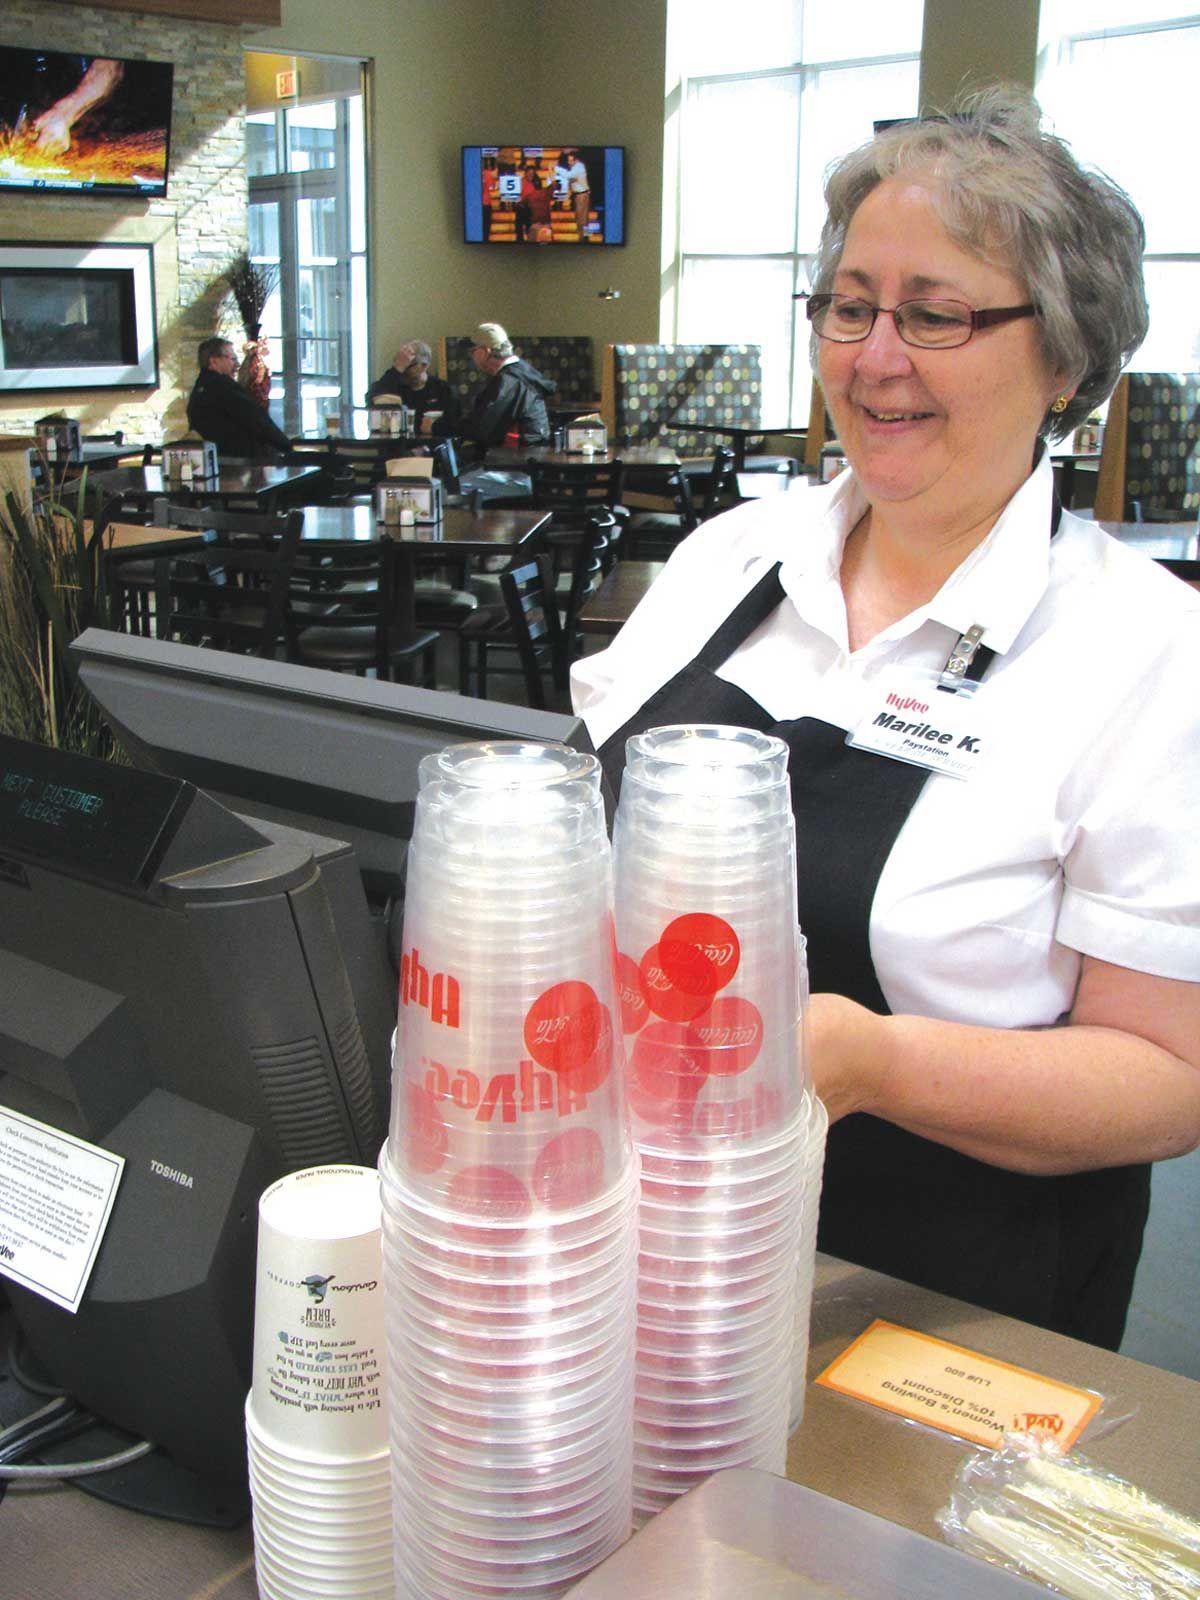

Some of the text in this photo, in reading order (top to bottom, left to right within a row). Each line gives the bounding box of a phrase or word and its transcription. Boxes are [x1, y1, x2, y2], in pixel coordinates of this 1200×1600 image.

[871, 711, 981, 754] Marilee K.
[902, 738, 950, 758] Paystation
[150, 1159, 194, 1189] TOSHIBA
[331, 1281, 378, 1292] Caribou
[306, 1308, 331, 1322] BREW
[880, 1381, 1006, 1433] Women's Bowling
[901, 1378, 996, 1418] 10% Discount
